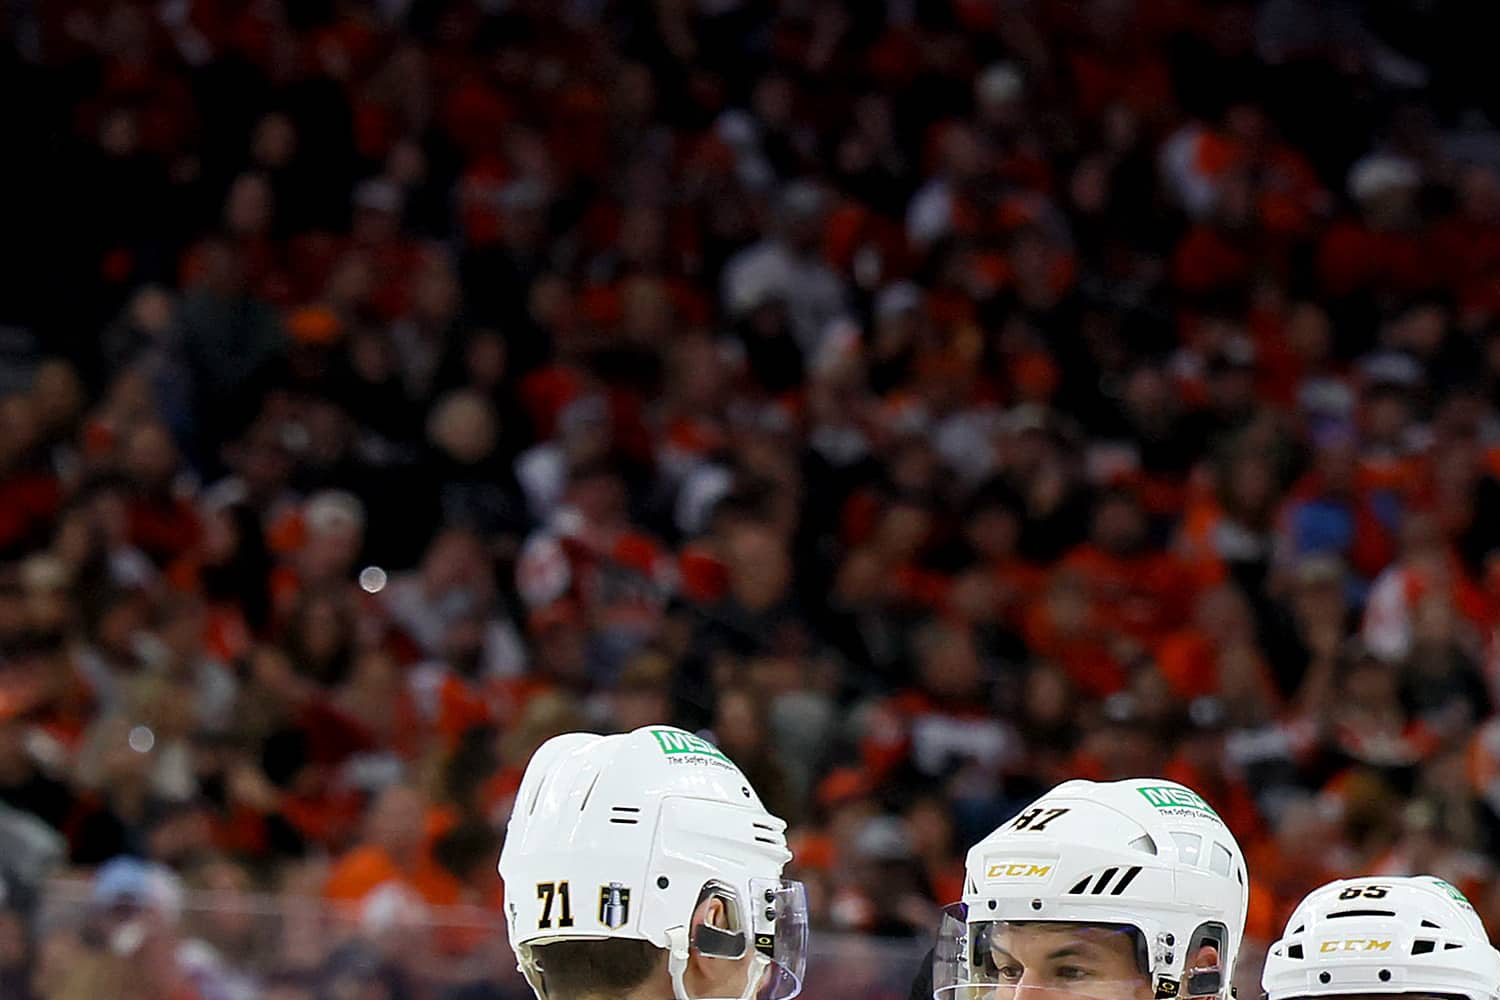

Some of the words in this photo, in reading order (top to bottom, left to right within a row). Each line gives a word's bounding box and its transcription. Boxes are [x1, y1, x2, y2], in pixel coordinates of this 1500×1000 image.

[988, 864, 1051, 877] CCM
[536, 880, 574, 929] 71
[1320, 939, 1392, 953] CCM
